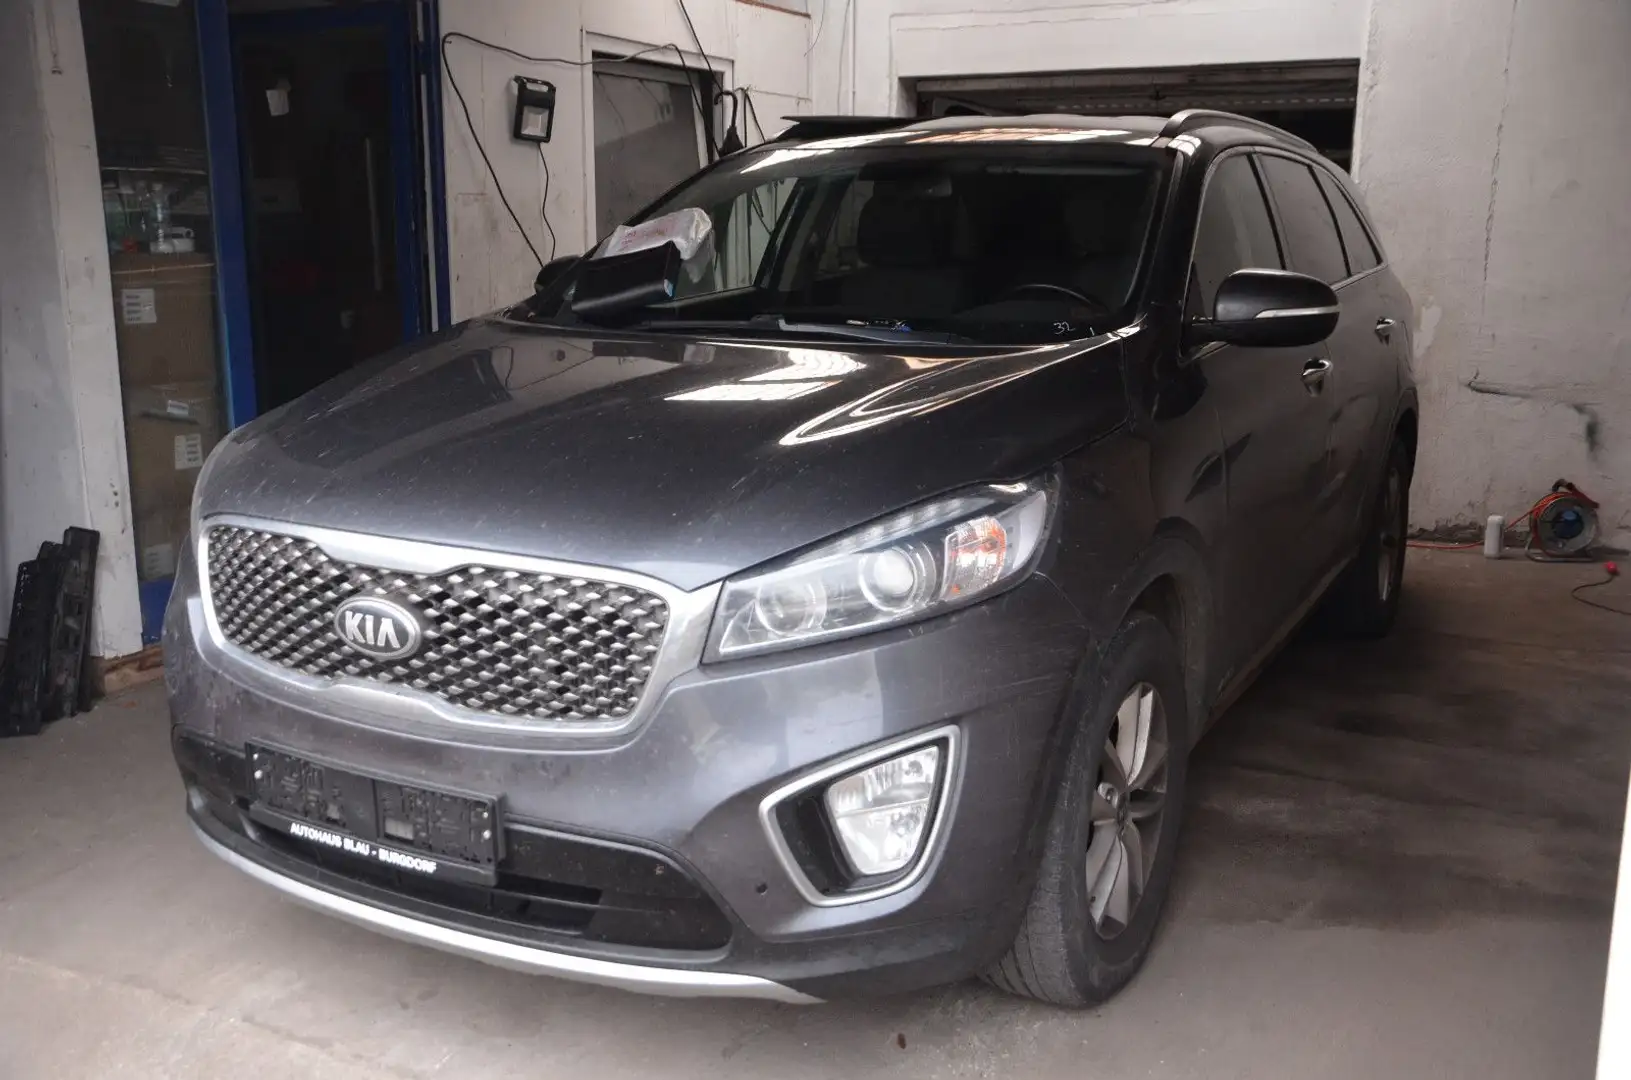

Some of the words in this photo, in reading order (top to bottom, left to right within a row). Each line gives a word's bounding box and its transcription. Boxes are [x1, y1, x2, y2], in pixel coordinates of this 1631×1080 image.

[344, 610, 401, 649] KIA
[290, 822, 343, 848] AUTOHAUS
[343, 837, 370, 856] BLAU
[378, 848, 437, 873] BURGDORF
